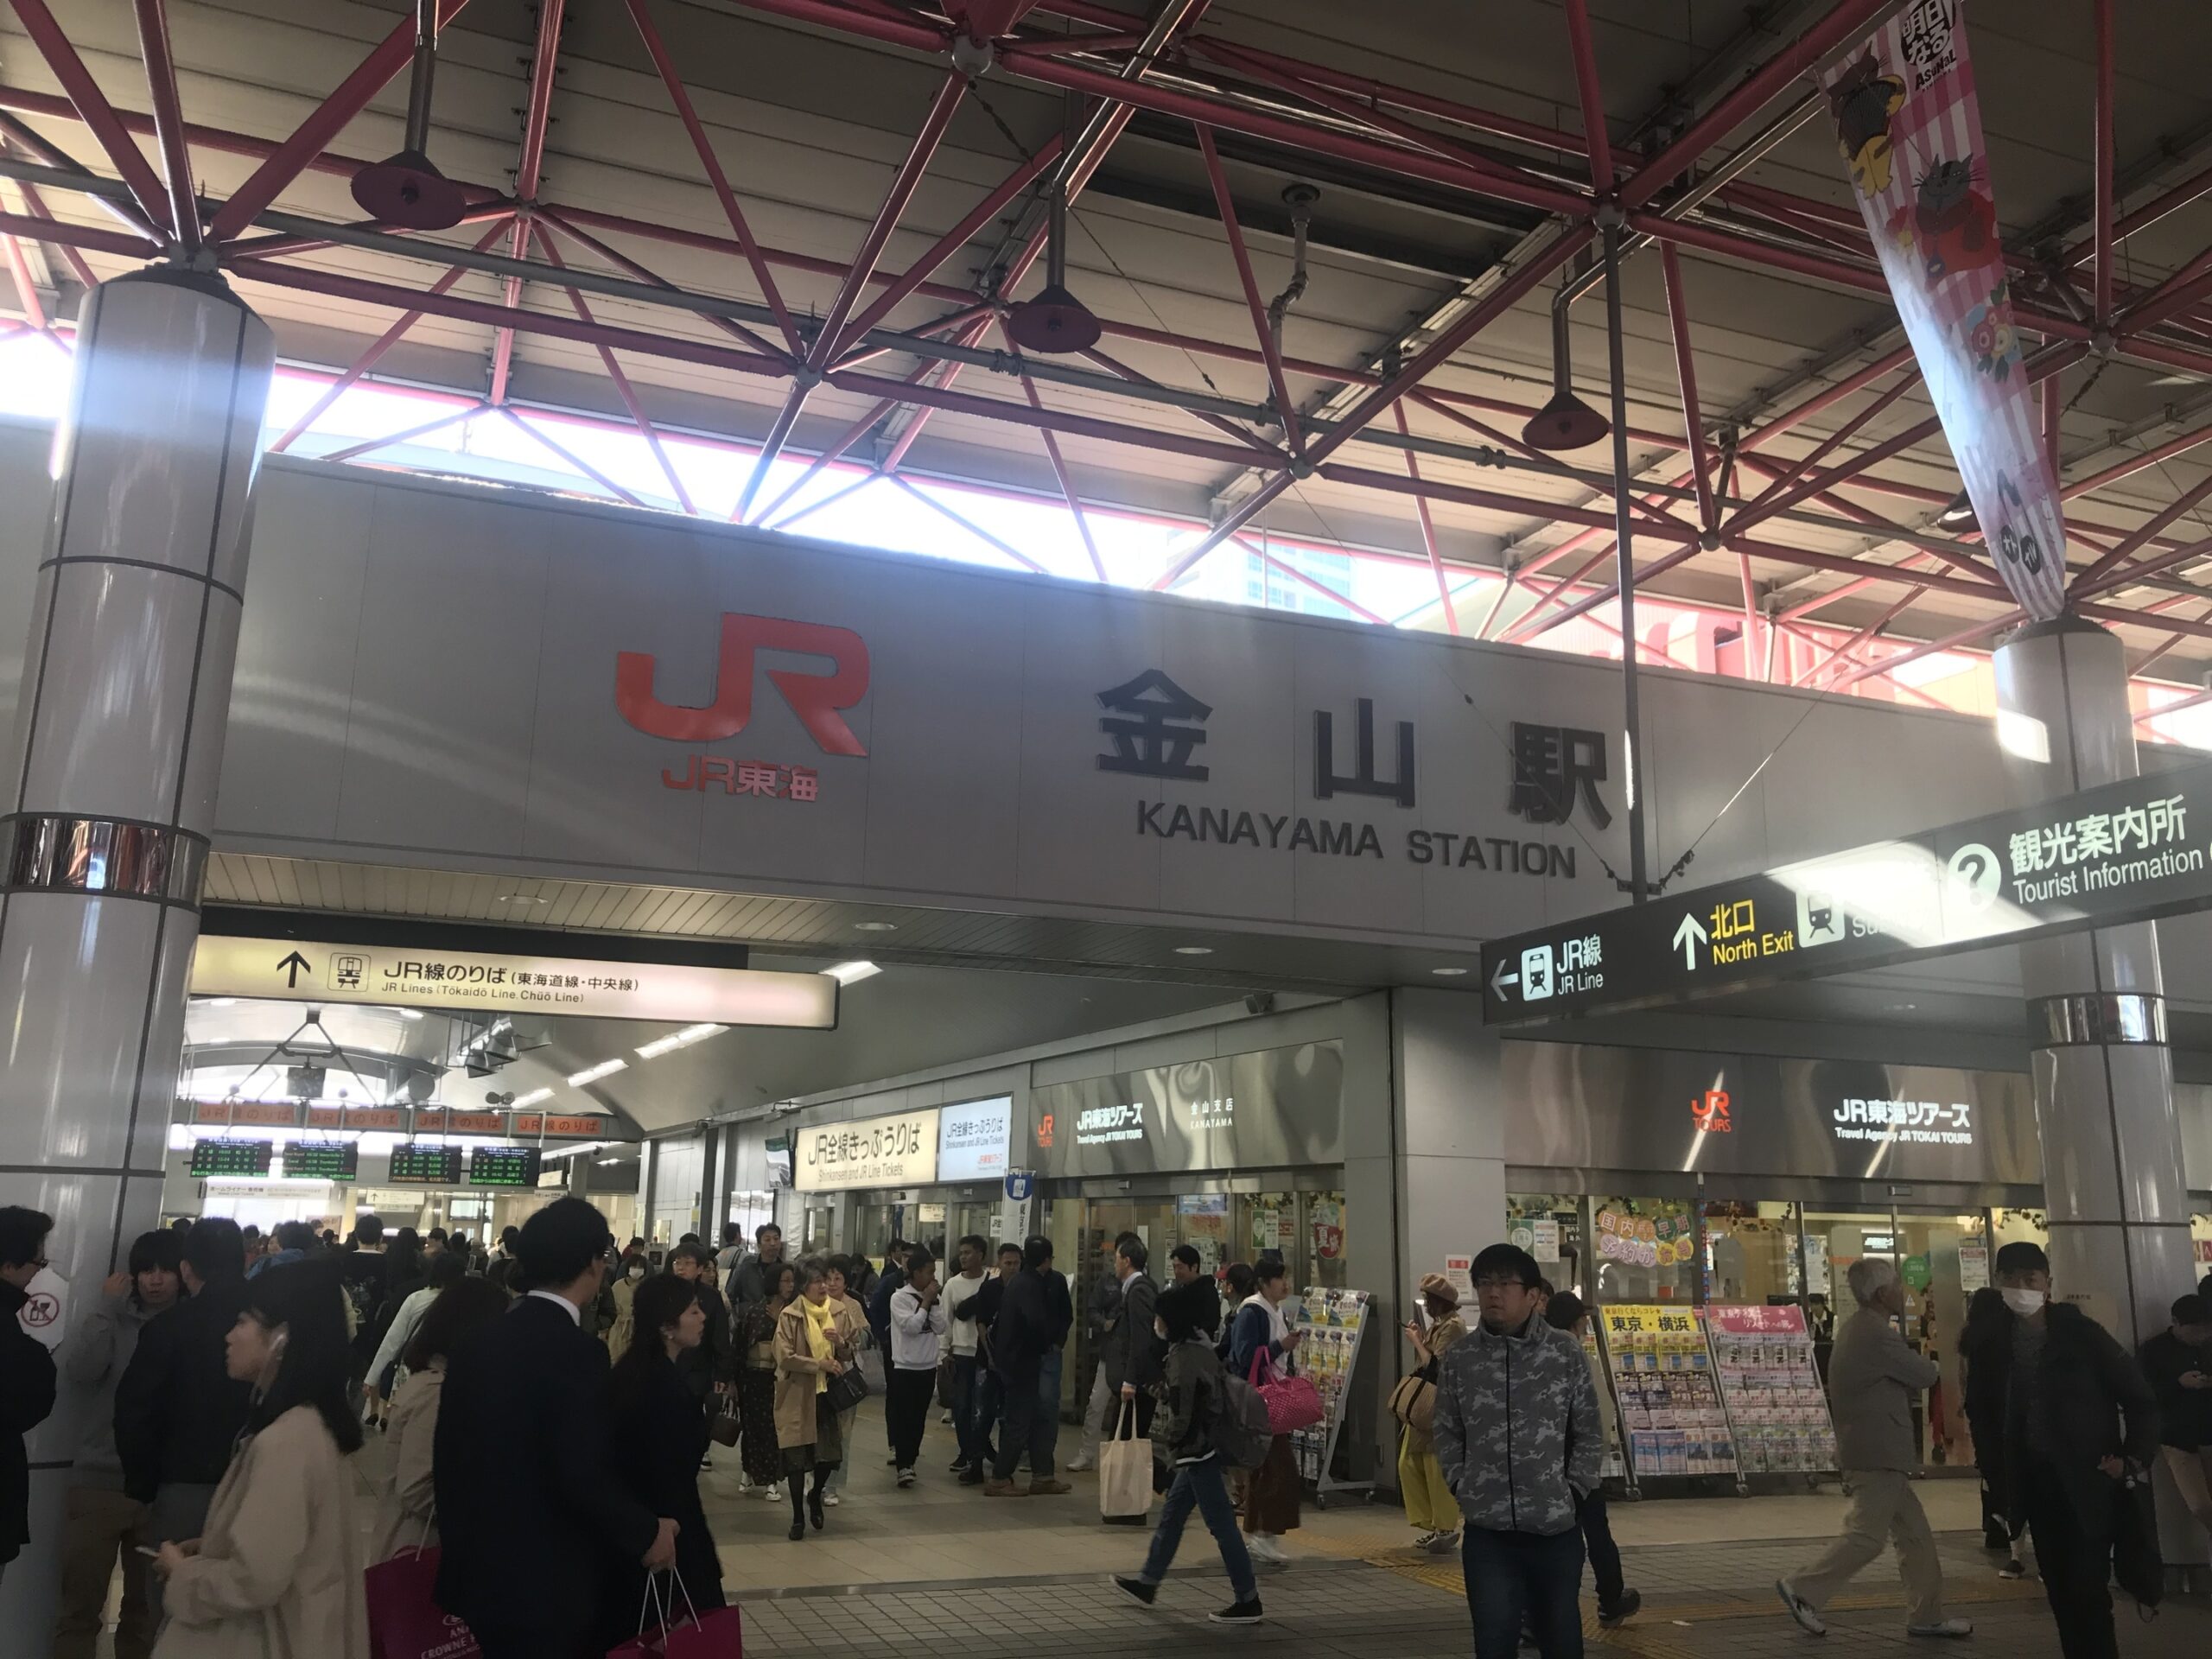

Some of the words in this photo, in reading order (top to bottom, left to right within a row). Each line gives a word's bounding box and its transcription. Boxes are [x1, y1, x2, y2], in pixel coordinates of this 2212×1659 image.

[615, 612, 870, 757] JR
[1097, 669, 1612, 830] 金山駅
[662, 754, 818, 802] JR東海
[1136, 800, 1384, 858] KANAYAMA
[1406, 830, 1576, 879] STATION
[2009, 794, 2186, 876] 観光案内所
[2013, 869, 2078, 904] Tourist
[2084, 849, 2203, 893] Information
[1710, 899, 1755, 940] 北口
[1556, 934, 1602, 974] JR線
[1713, 938, 1758, 965] North
[1763, 930, 1794, 956] Exit
[384, 961, 507, 984] JR線のりば
[1557, 976, 1573, 995] JR
[1577, 972, 1604, 991] Line
[382, 982, 397, 992] JR
[401, 982, 434, 994] Lines
[1191, 1097, 1234, 1116] 金山支店
[1692, 1090, 1730, 1116] JR
[1834, 1098, 1971, 1128] JR東海ツアーズ
[946, 1116, 1003, 1138] JR全線きっぷうりば
[1038, 1116, 1053, 1135] JR
[1190, 1117, 1233, 1129] KANAYAMA
[1693, 1117, 1732, 1132] TOURS
[1834, 1127, 1864, 1139] Travel
[1899, 1130, 1911, 1141] JR
[1911, 1130, 1941, 1143] TOKAI
[1941, 1132, 1973, 1144] TOURS
[808, 1122, 921, 1166] JR全線きっぷうりば
[868, 1163, 880, 1179] Line
[882, 1161, 903, 1177] Tickets
[1611, 1315, 1690, 1332] 東京・横浜
